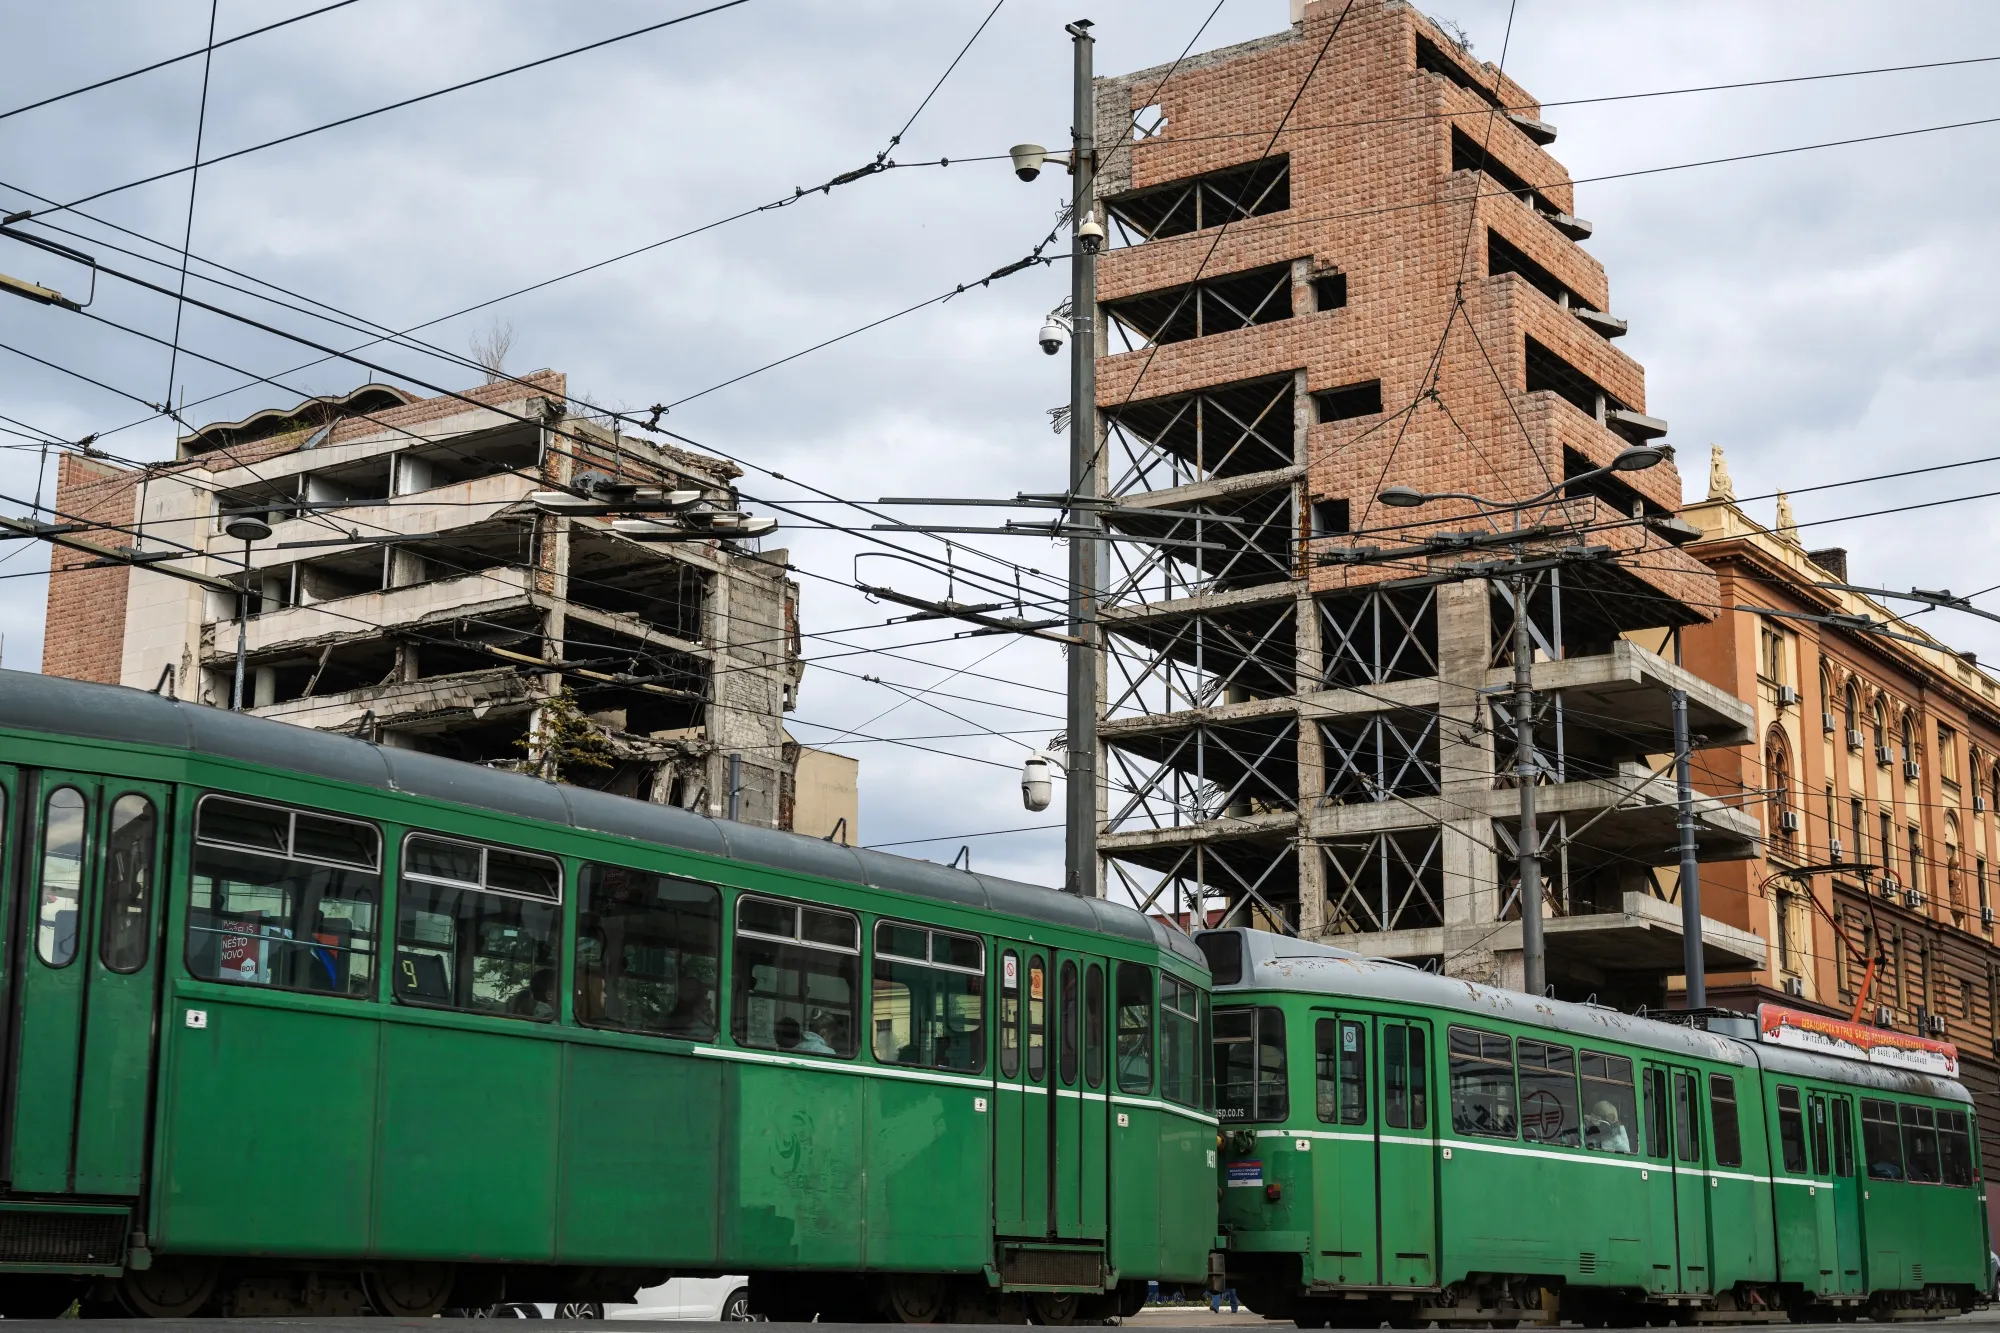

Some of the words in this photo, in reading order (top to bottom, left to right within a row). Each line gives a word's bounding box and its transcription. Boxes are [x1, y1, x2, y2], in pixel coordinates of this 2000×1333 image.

[222, 936, 248, 949] NEŠTO
[221, 949, 243, 960] NOVO
[241, 964, 255, 973] BOX
[402, 960, 417, 988] 9
